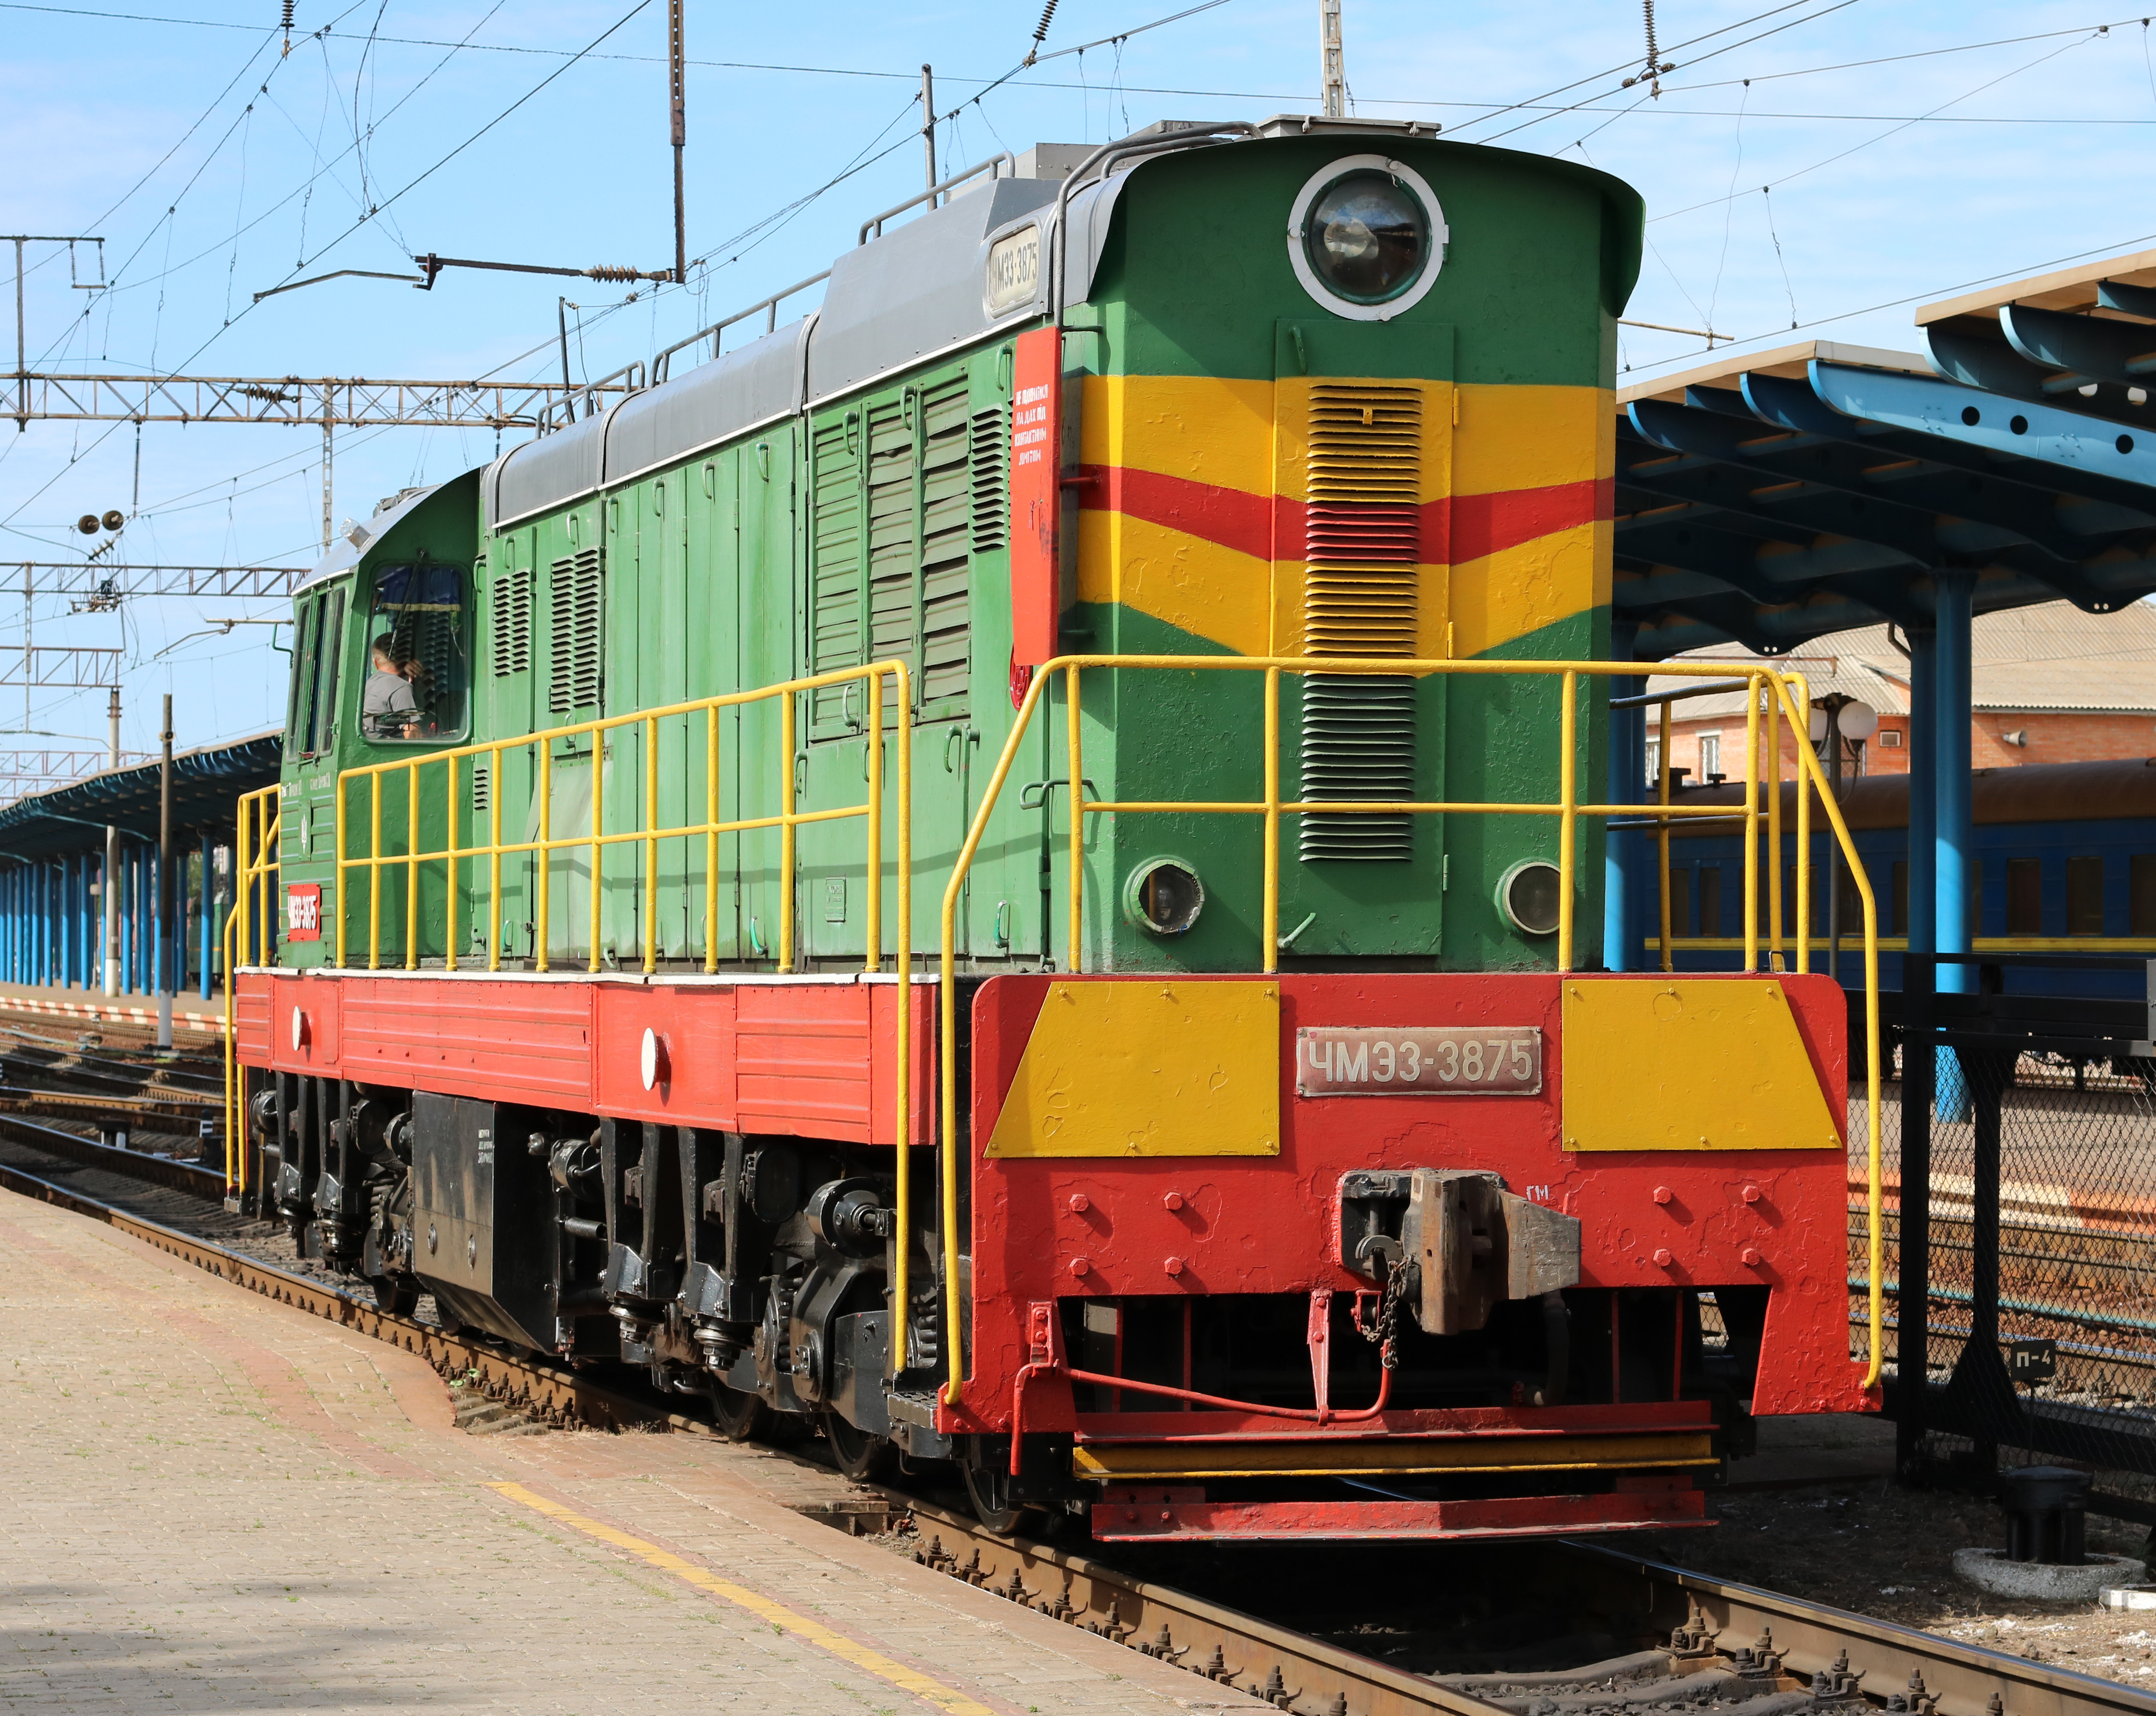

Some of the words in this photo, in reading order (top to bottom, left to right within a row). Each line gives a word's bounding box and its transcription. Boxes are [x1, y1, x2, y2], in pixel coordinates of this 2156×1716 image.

[1016, 391, 1022, 406] НЕ
[1016, 412, 1023, 426] НА
[1024, 408, 1036, 425] ДАХ
[1037, 404, 1046, 422] ПІД
[1015, 427, 1046, 447] КОНТАКТНИМ
[1019, 449, 1041, 466] ДРОТОМ
[1309, 1040, 1533, 1082] ЧМЭ3-3875
[2017, 1349, 2050, 1367] П-4
